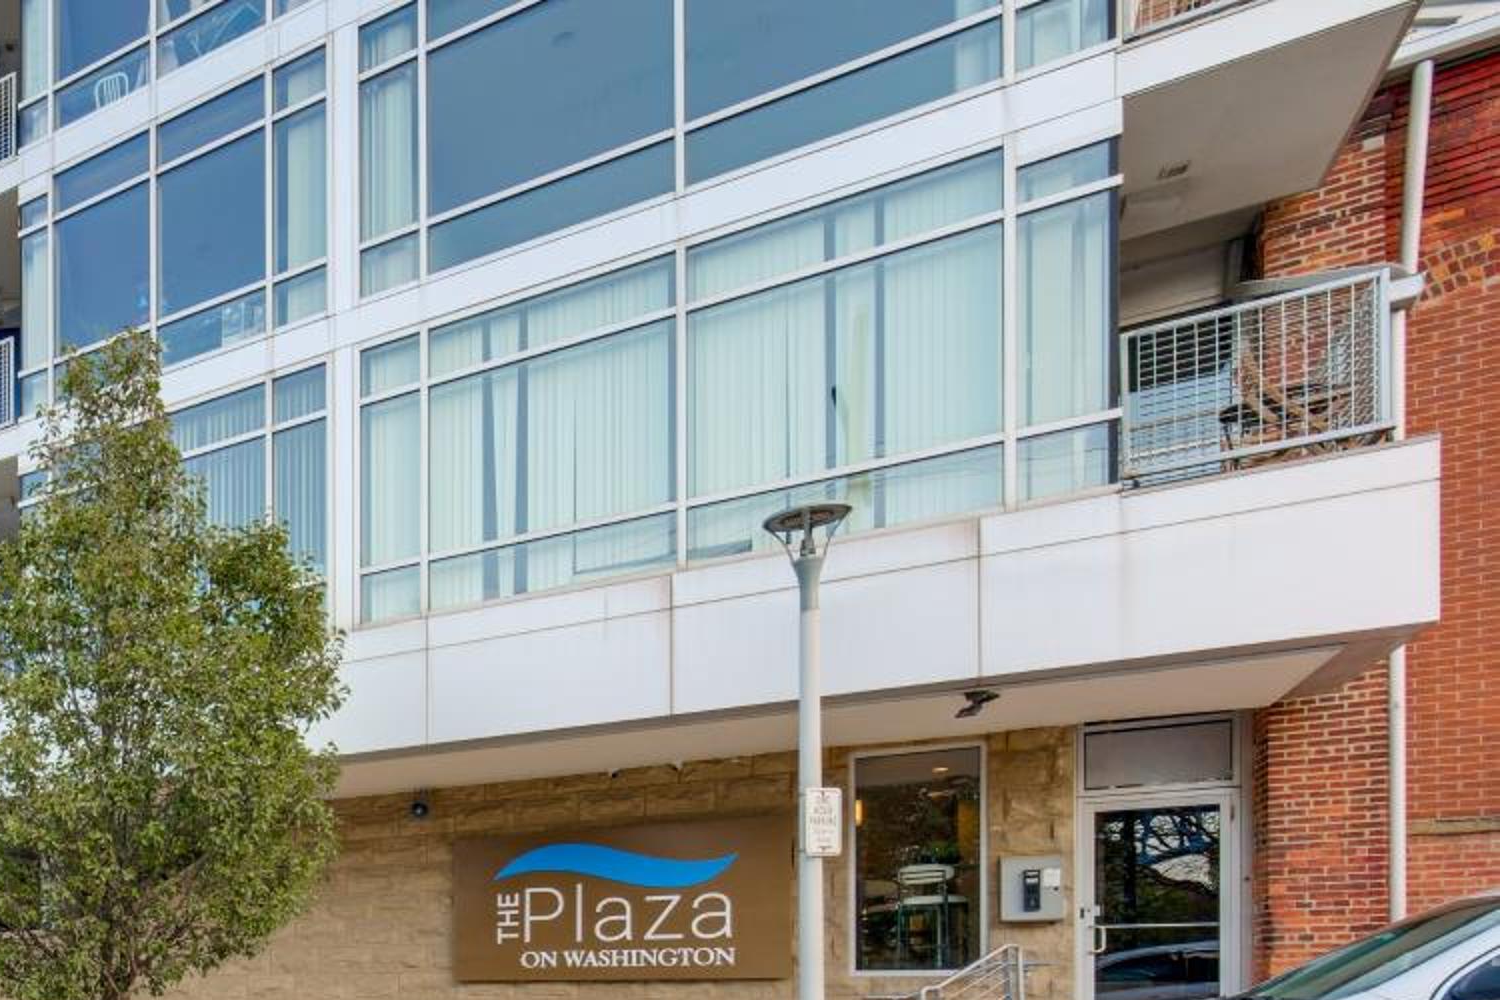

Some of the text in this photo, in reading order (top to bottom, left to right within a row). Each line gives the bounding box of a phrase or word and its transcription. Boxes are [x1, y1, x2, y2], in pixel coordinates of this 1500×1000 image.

[497, 892, 520, 945] THE
[523, 883, 734, 944] Plaza
[520, 947, 735, 969] ON WASHINGTON
